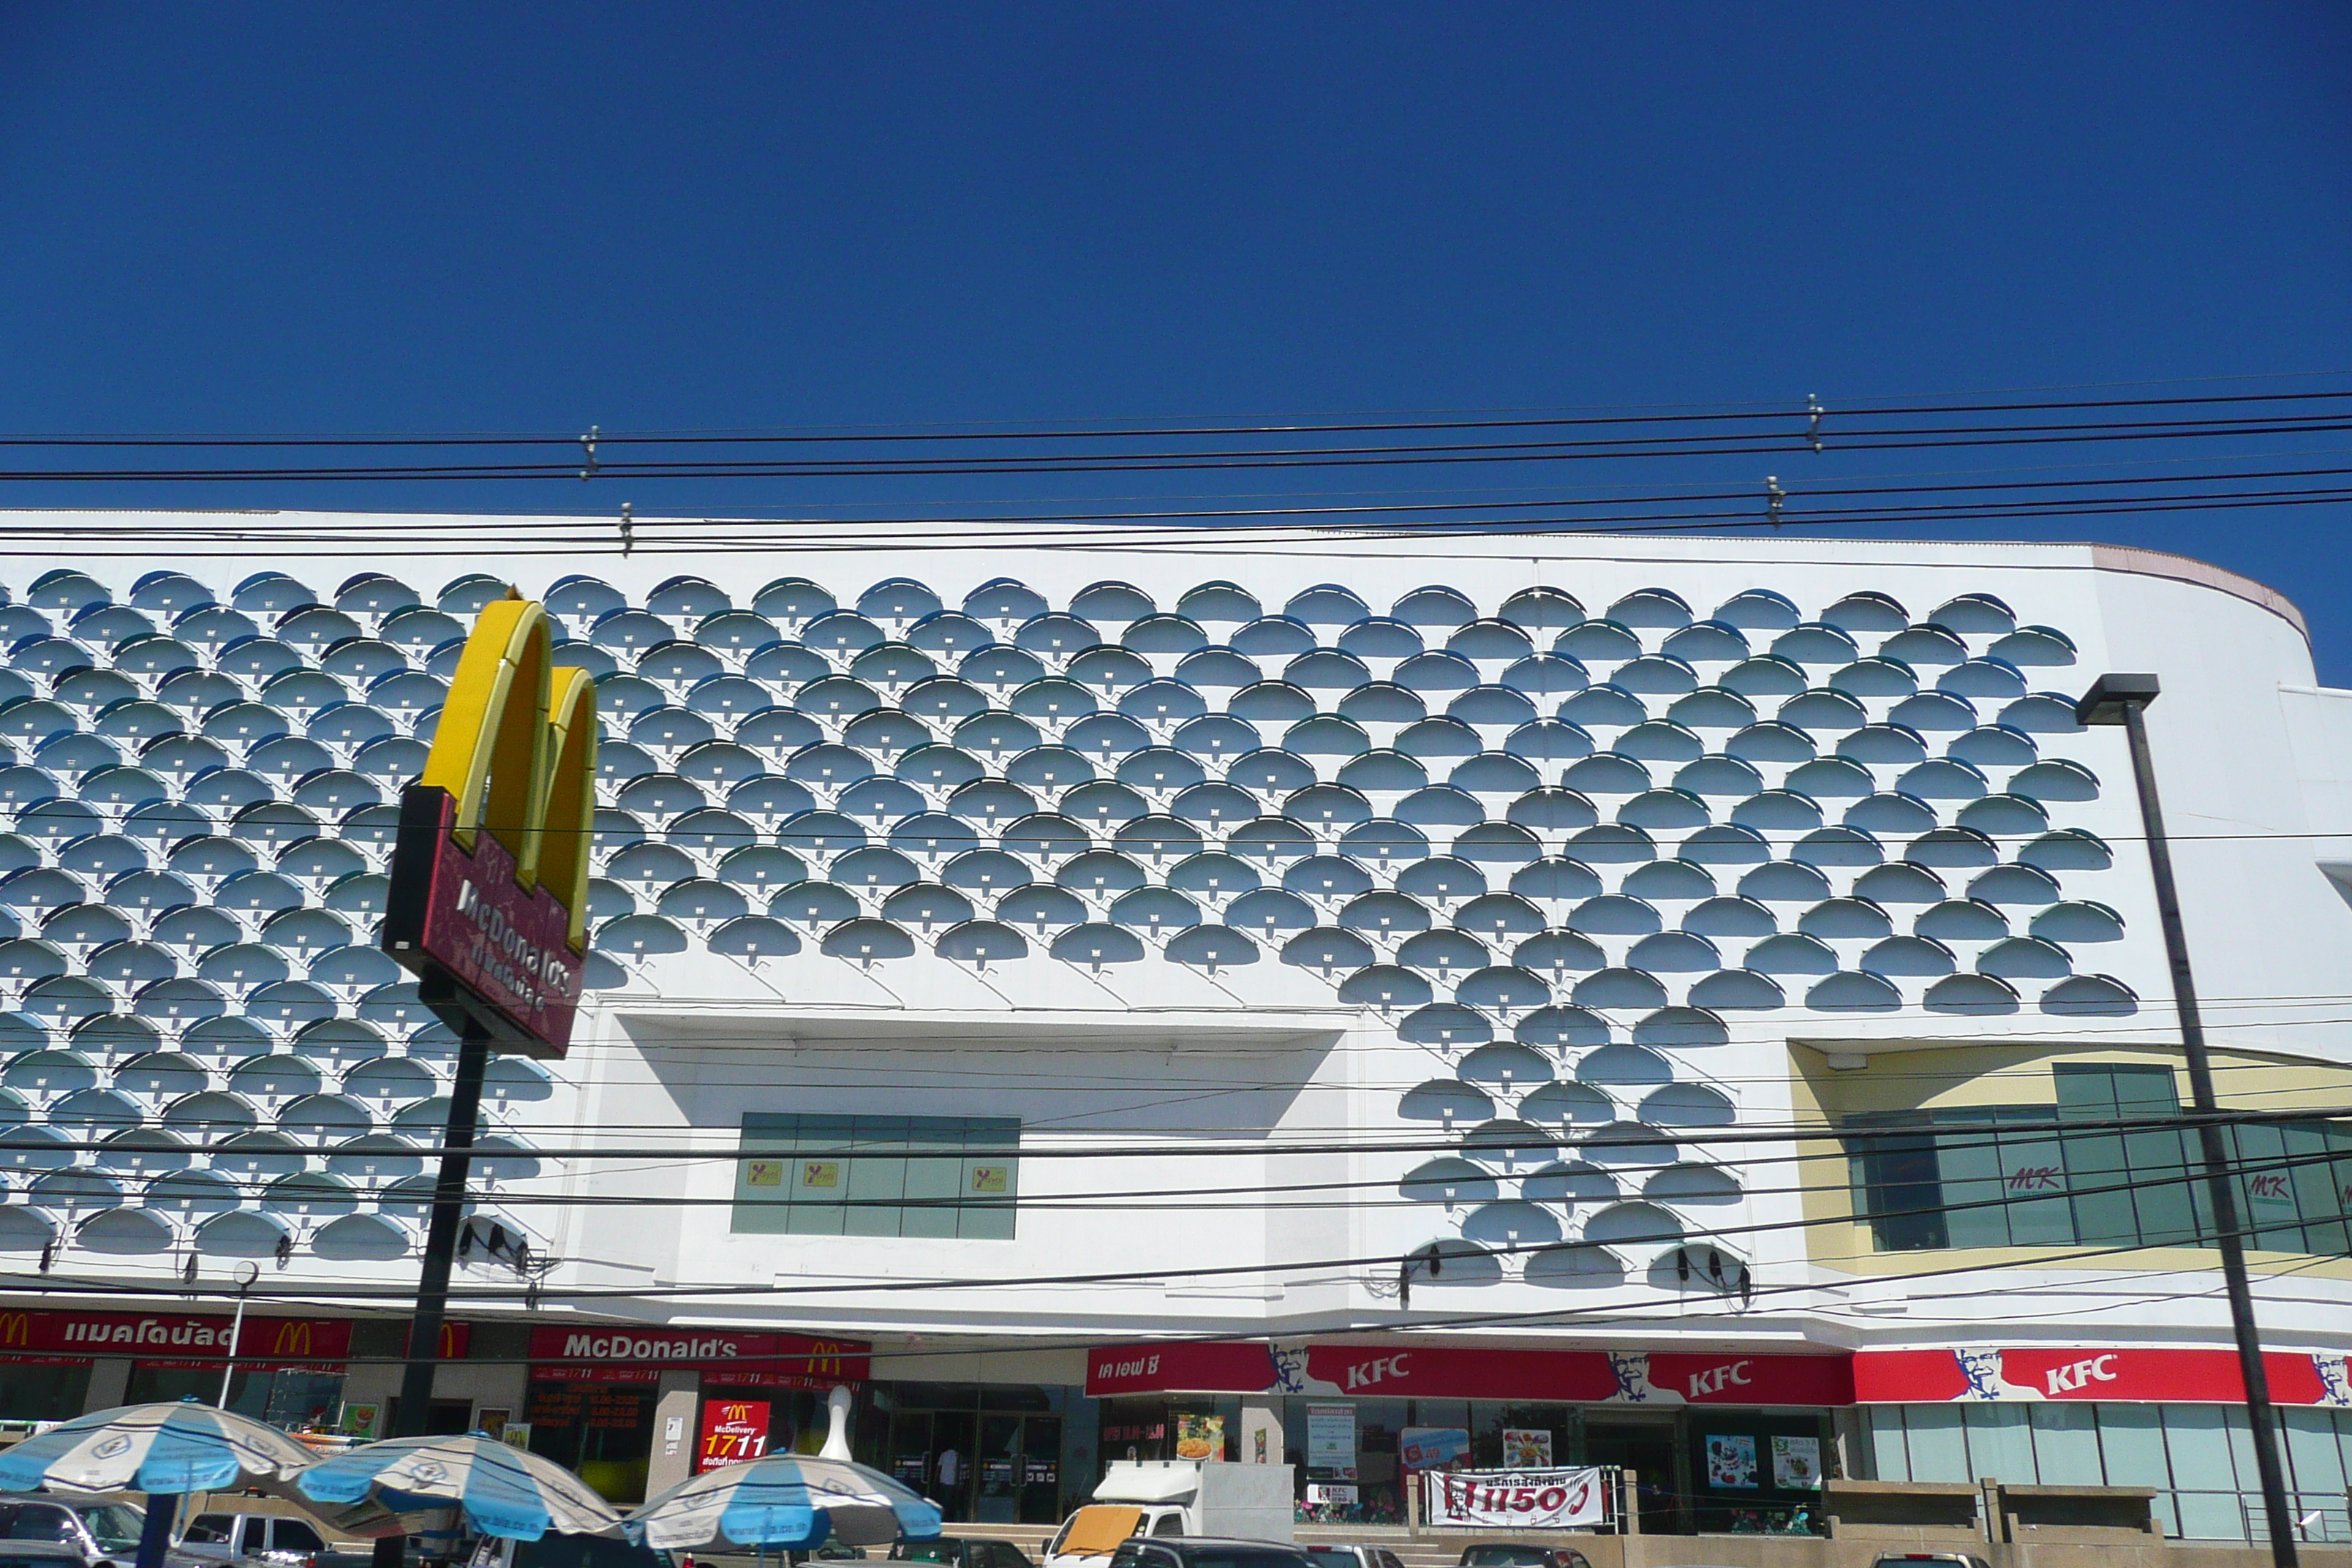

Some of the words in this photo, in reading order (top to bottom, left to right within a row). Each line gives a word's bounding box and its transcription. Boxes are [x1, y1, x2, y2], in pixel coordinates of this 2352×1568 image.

[456, 879, 570, 998] McDonald's
[2009, 1166, 2060, 1189] MK
[2249, 1175, 2290, 1199] MK
[64, 1319, 235, 1346] แมคโดนัลด์
[563, 1333, 738, 1358] McDonald's
[1346, 1353, 1410, 1390] KFC
[1689, 1360, 1752, 1398] KFC
[2046, 1354, 2118, 1395] KFC
[715, 1425, 756, 1435] McDelivery
[706, 1434, 766, 1456] 1711
[1481, 1487, 1567, 1512] 1150
